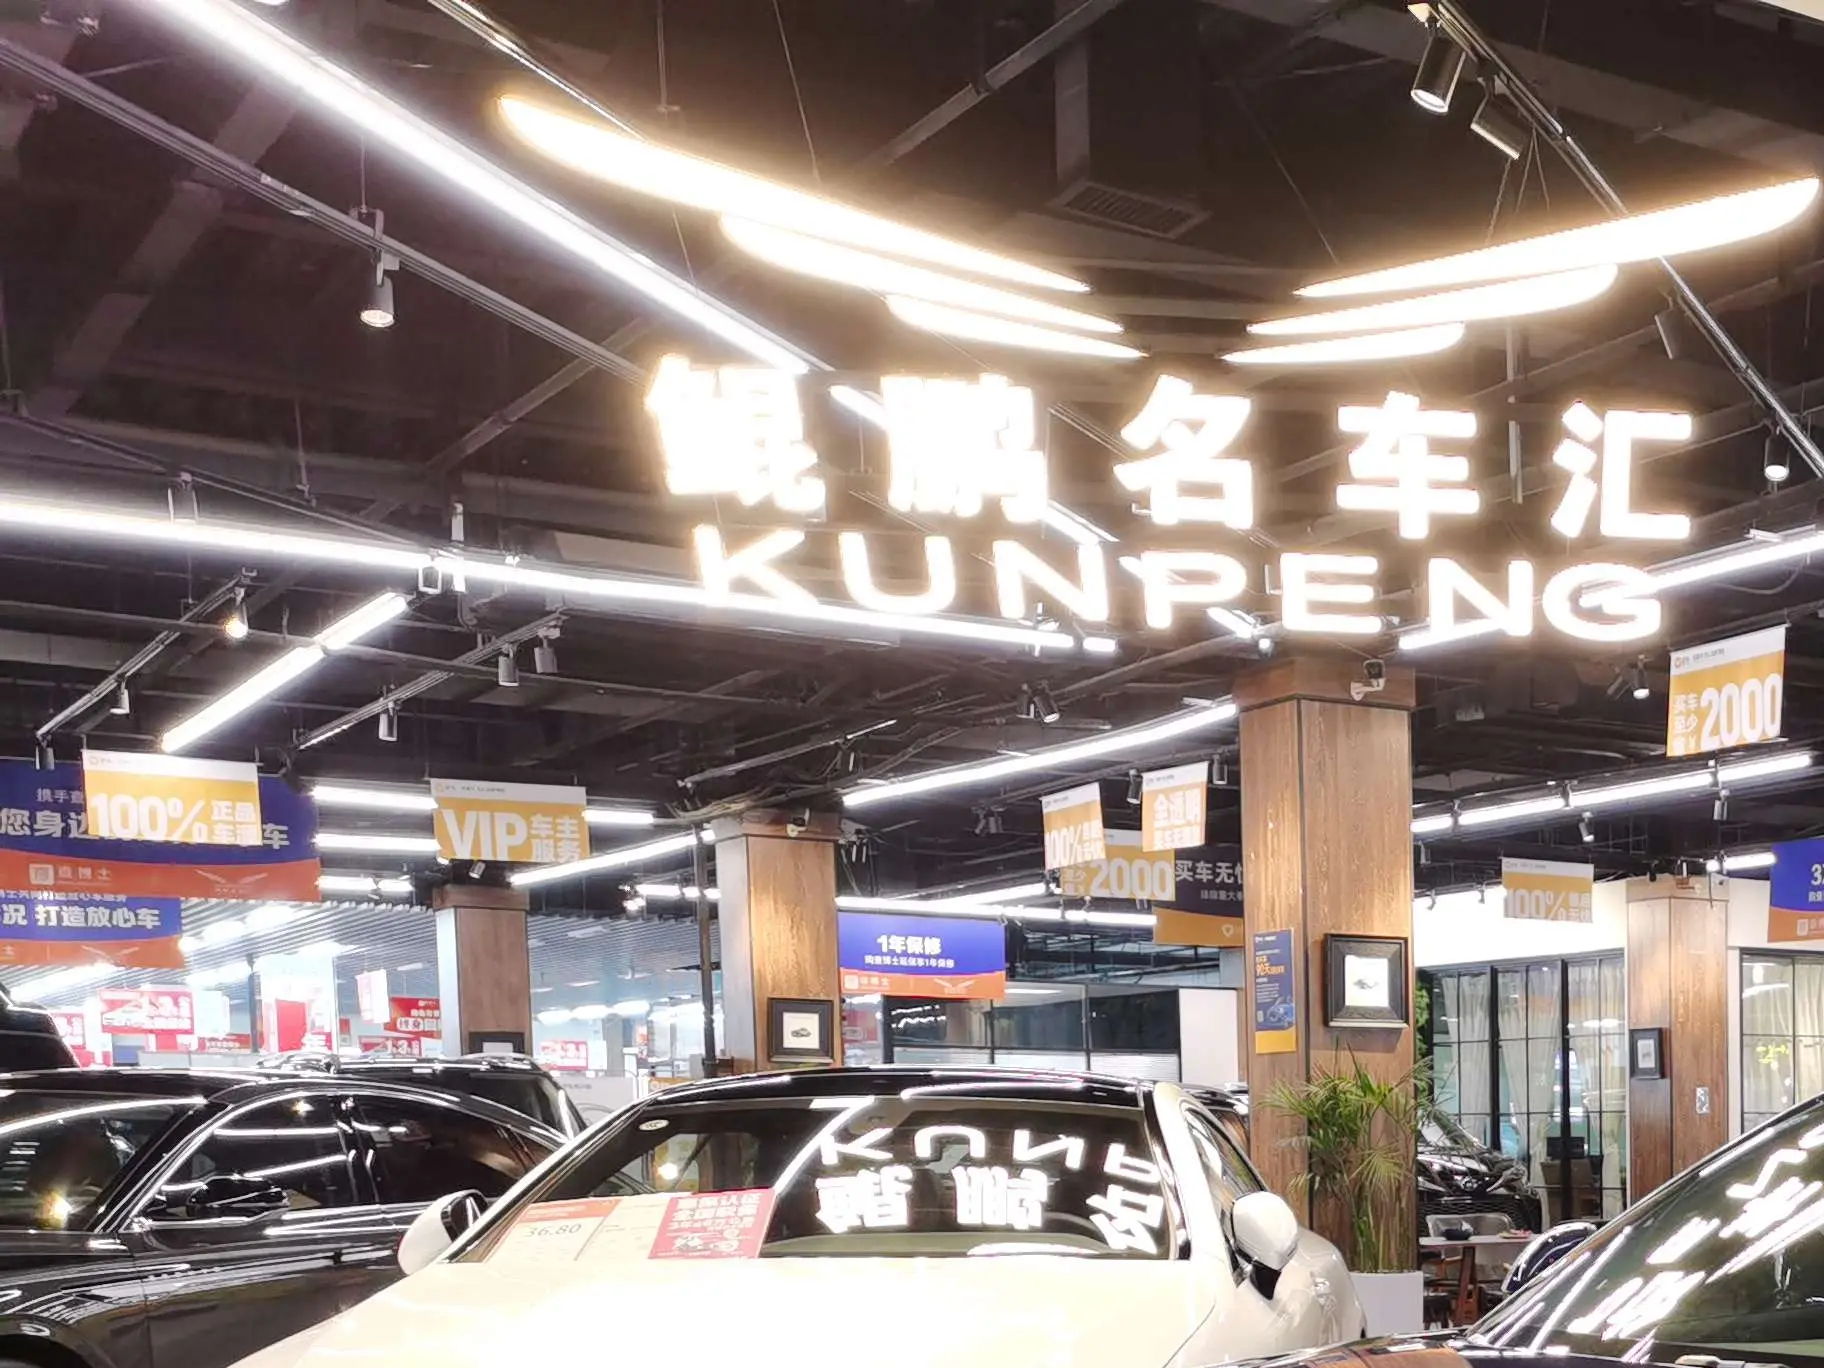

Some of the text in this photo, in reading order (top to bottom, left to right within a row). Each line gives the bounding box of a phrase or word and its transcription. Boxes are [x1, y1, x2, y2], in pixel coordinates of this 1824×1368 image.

[693, 524, 1663, 640] KUNPENG
[1700, 672, 1782, 752] 2000
[90, 793, 207, 844] 100%
[211, 800, 257, 823] 正品
[529, 813, 580, 839] 车主
[442, 809, 528, 862] VIP
[531, 838, 581, 863] 服务
[1091, 858, 1173, 900] 2000
[35, 904, 161, 929] 打造放心车
[1504, 888, 1569, 922] 100%
[876, 934, 942, 956] 1年保修
[525, 1222, 582, 1239] 36.80
